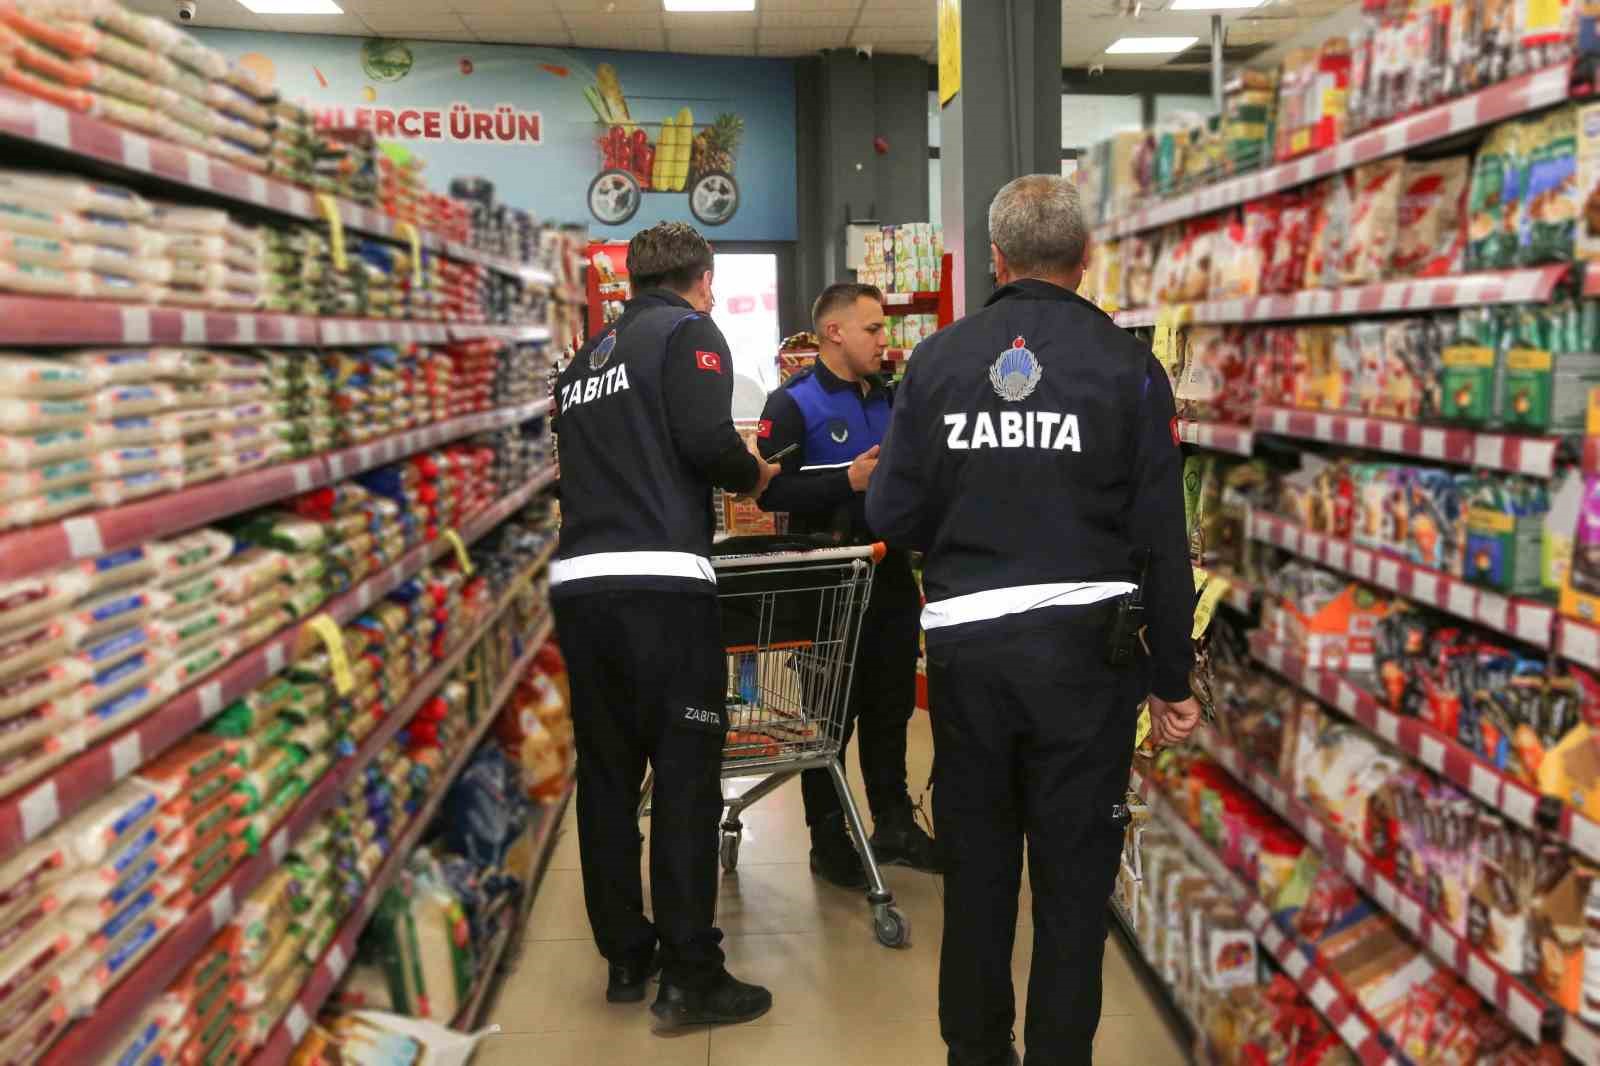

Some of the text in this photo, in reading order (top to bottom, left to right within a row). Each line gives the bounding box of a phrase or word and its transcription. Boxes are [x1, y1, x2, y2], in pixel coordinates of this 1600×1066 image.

[450, 105, 540, 141] ÜRÜN
[561, 362, 630, 415] ZABITA
[943, 411, 1082, 452] ZABITA
